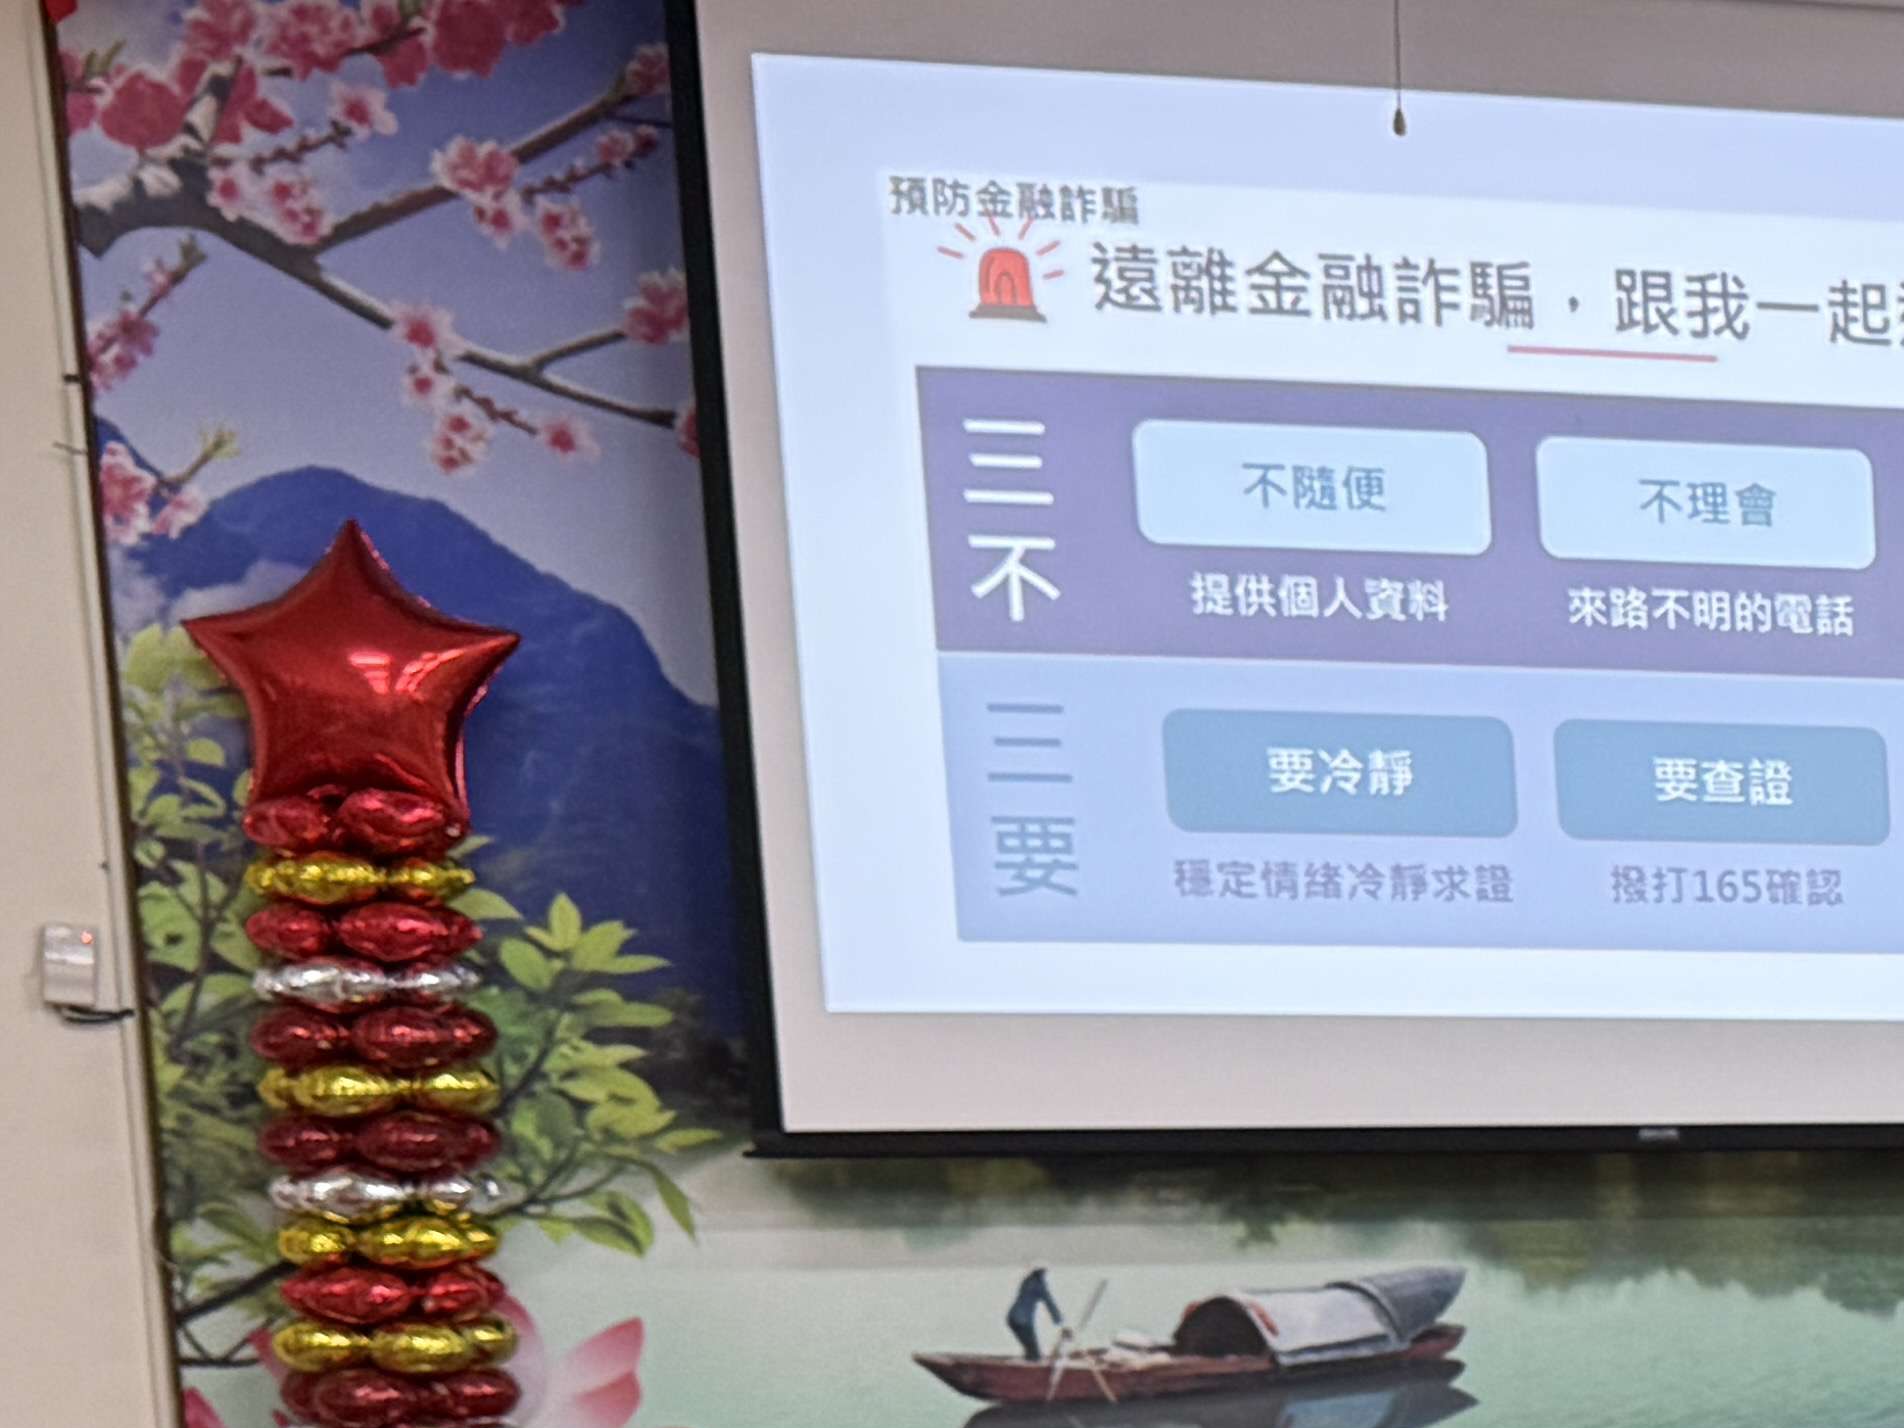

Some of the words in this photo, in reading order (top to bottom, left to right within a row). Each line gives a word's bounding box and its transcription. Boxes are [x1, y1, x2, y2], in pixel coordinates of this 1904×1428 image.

[888, 175, 1139, 225] 預防金融詐騙
[1241, 461, 1388, 514] 不隨便
[1637, 477, 1777, 528] 不理會
[962, 418, 1061, 623] 三不
[1190, 573, 1449, 623] 提供個人資料
[1567, 587, 1855, 637] 來路不明的電話
[1265, 746, 1414, 798] 要冷靜
[1653, 756, 1794, 807] 要查證
[986, 702, 1079, 898] 三要
[1173, 858, 1514, 903] 穩定情緒冷靜求證
[1609, 865, 1845, 909] 撥打165確認
